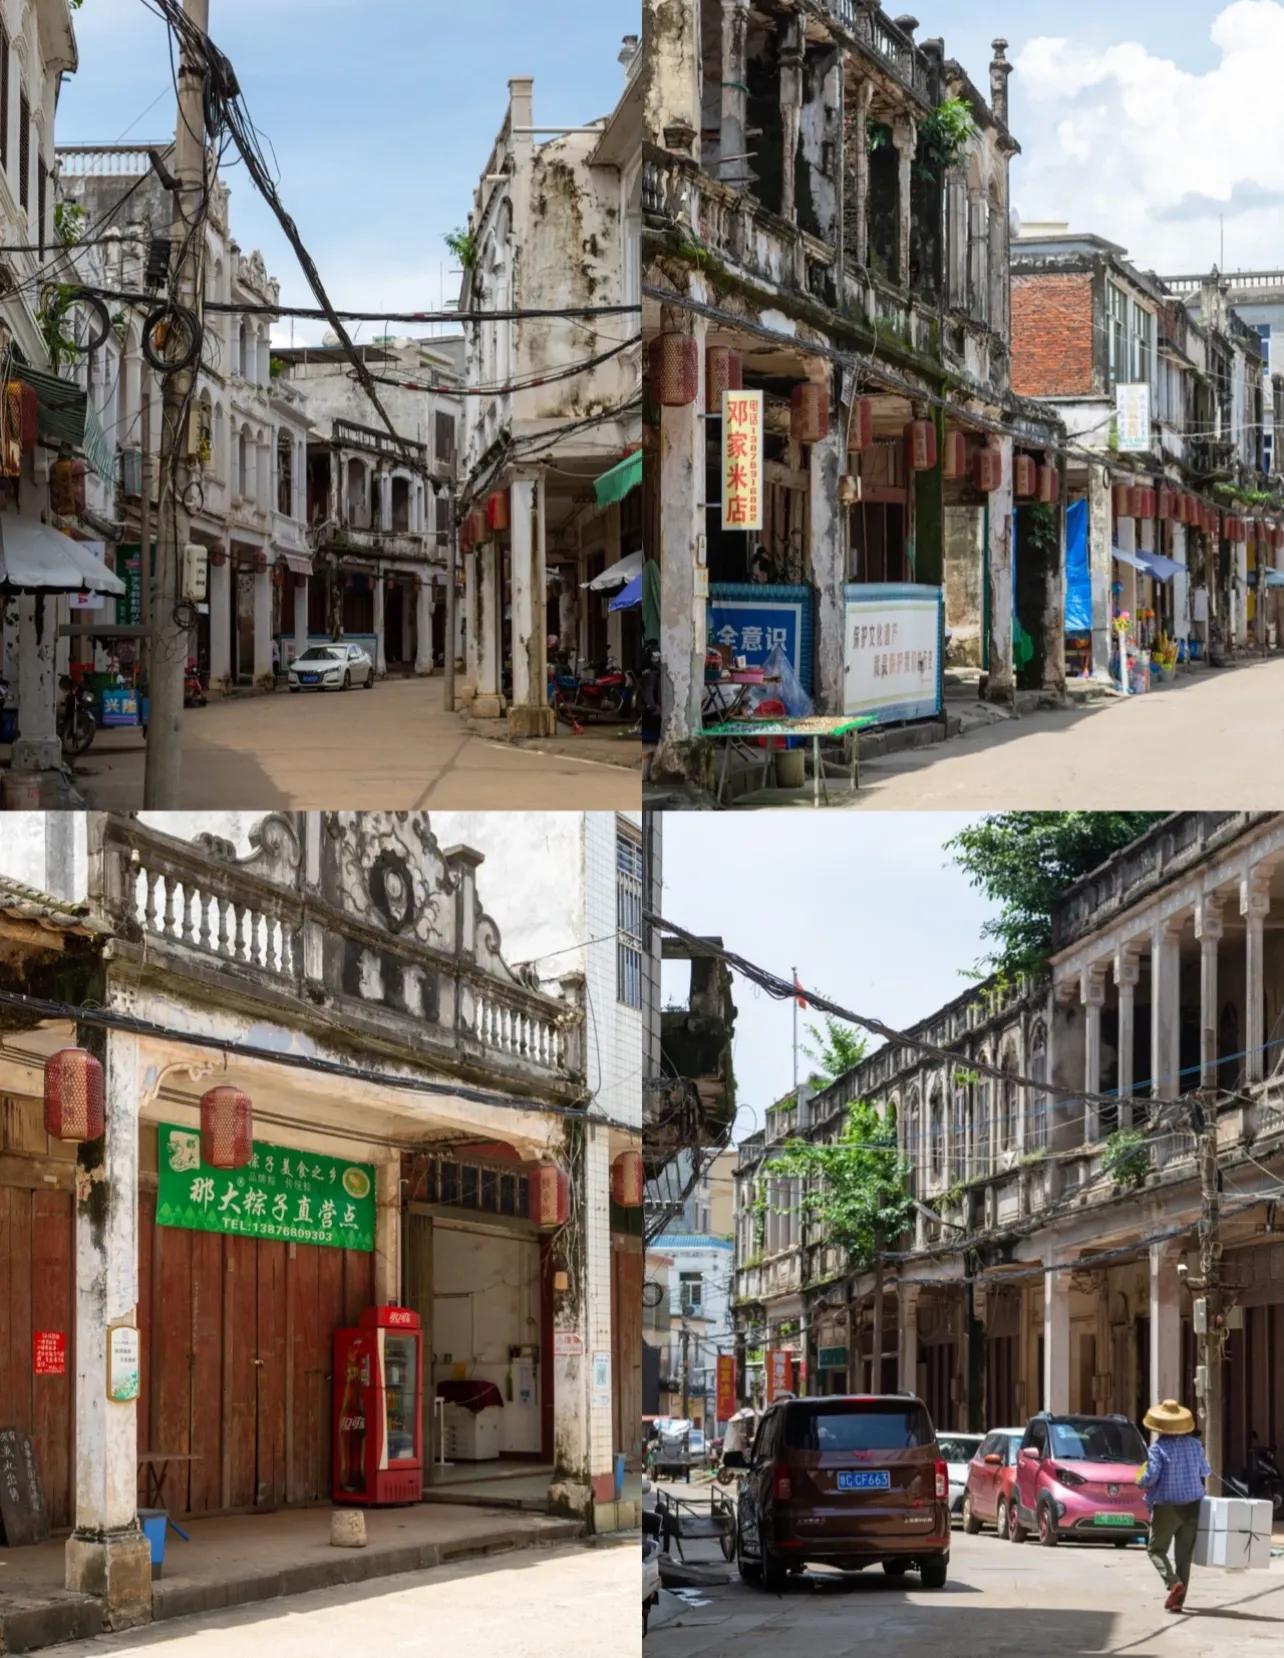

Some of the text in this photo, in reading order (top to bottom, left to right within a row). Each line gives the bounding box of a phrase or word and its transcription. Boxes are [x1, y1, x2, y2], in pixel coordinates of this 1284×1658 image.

[726, 400, 748, 523] 邓家米店
[707, 624, 788, 651] 全意识
[189, 1176, 359, 1230] 那大粽子直营点
